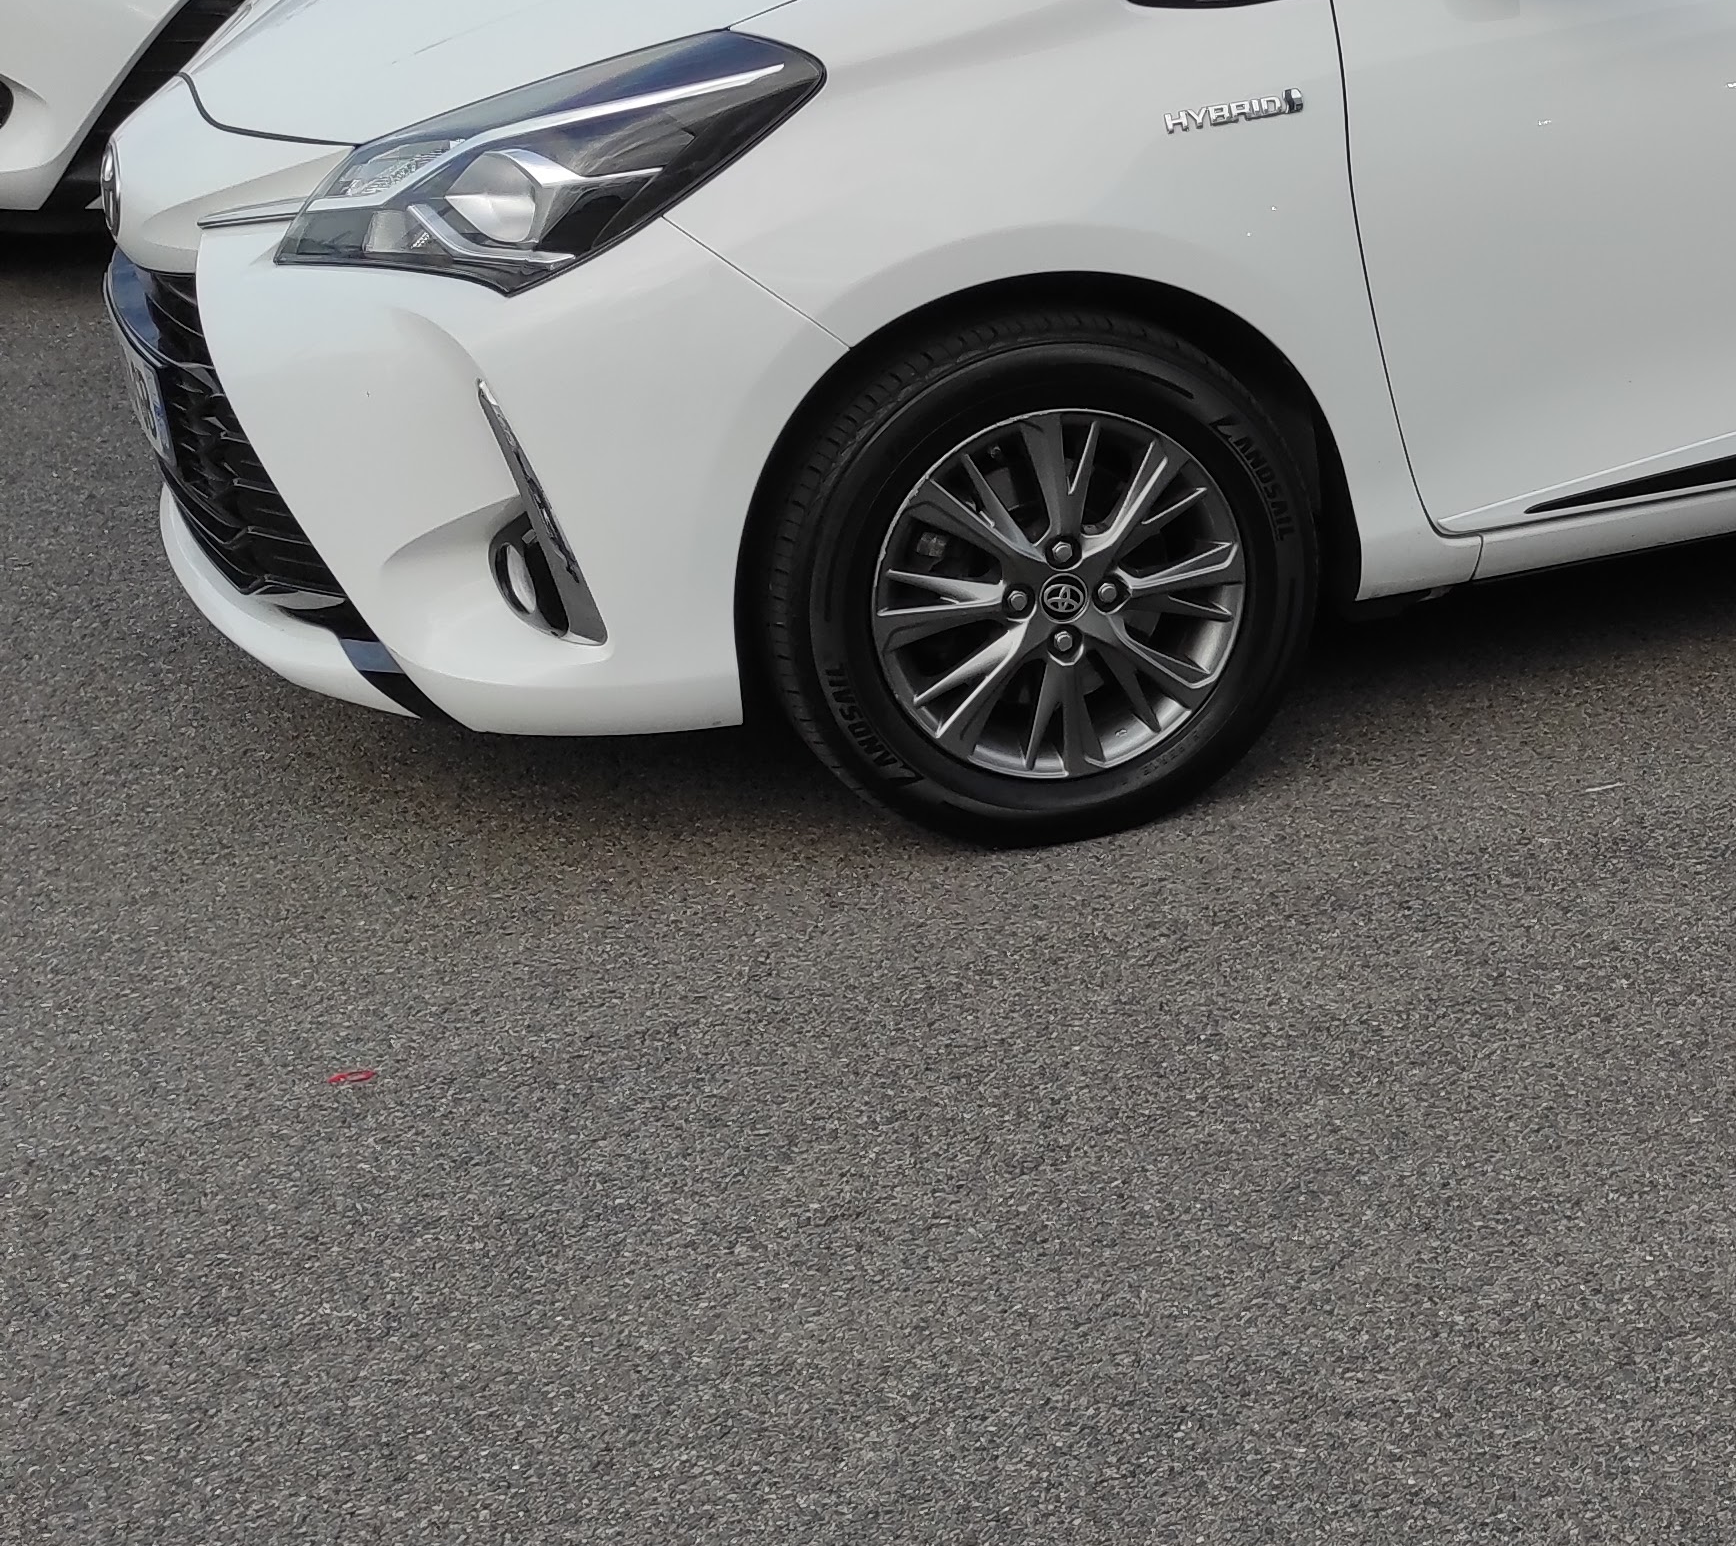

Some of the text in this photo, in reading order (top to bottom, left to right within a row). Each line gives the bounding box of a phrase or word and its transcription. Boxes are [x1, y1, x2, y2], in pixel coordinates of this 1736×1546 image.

[1163, 95, 1284, 135] HYBRID
[1209, 415, 1296, 542] LANDSAIL
[824, 662, 925, 787] LANDSAIL
